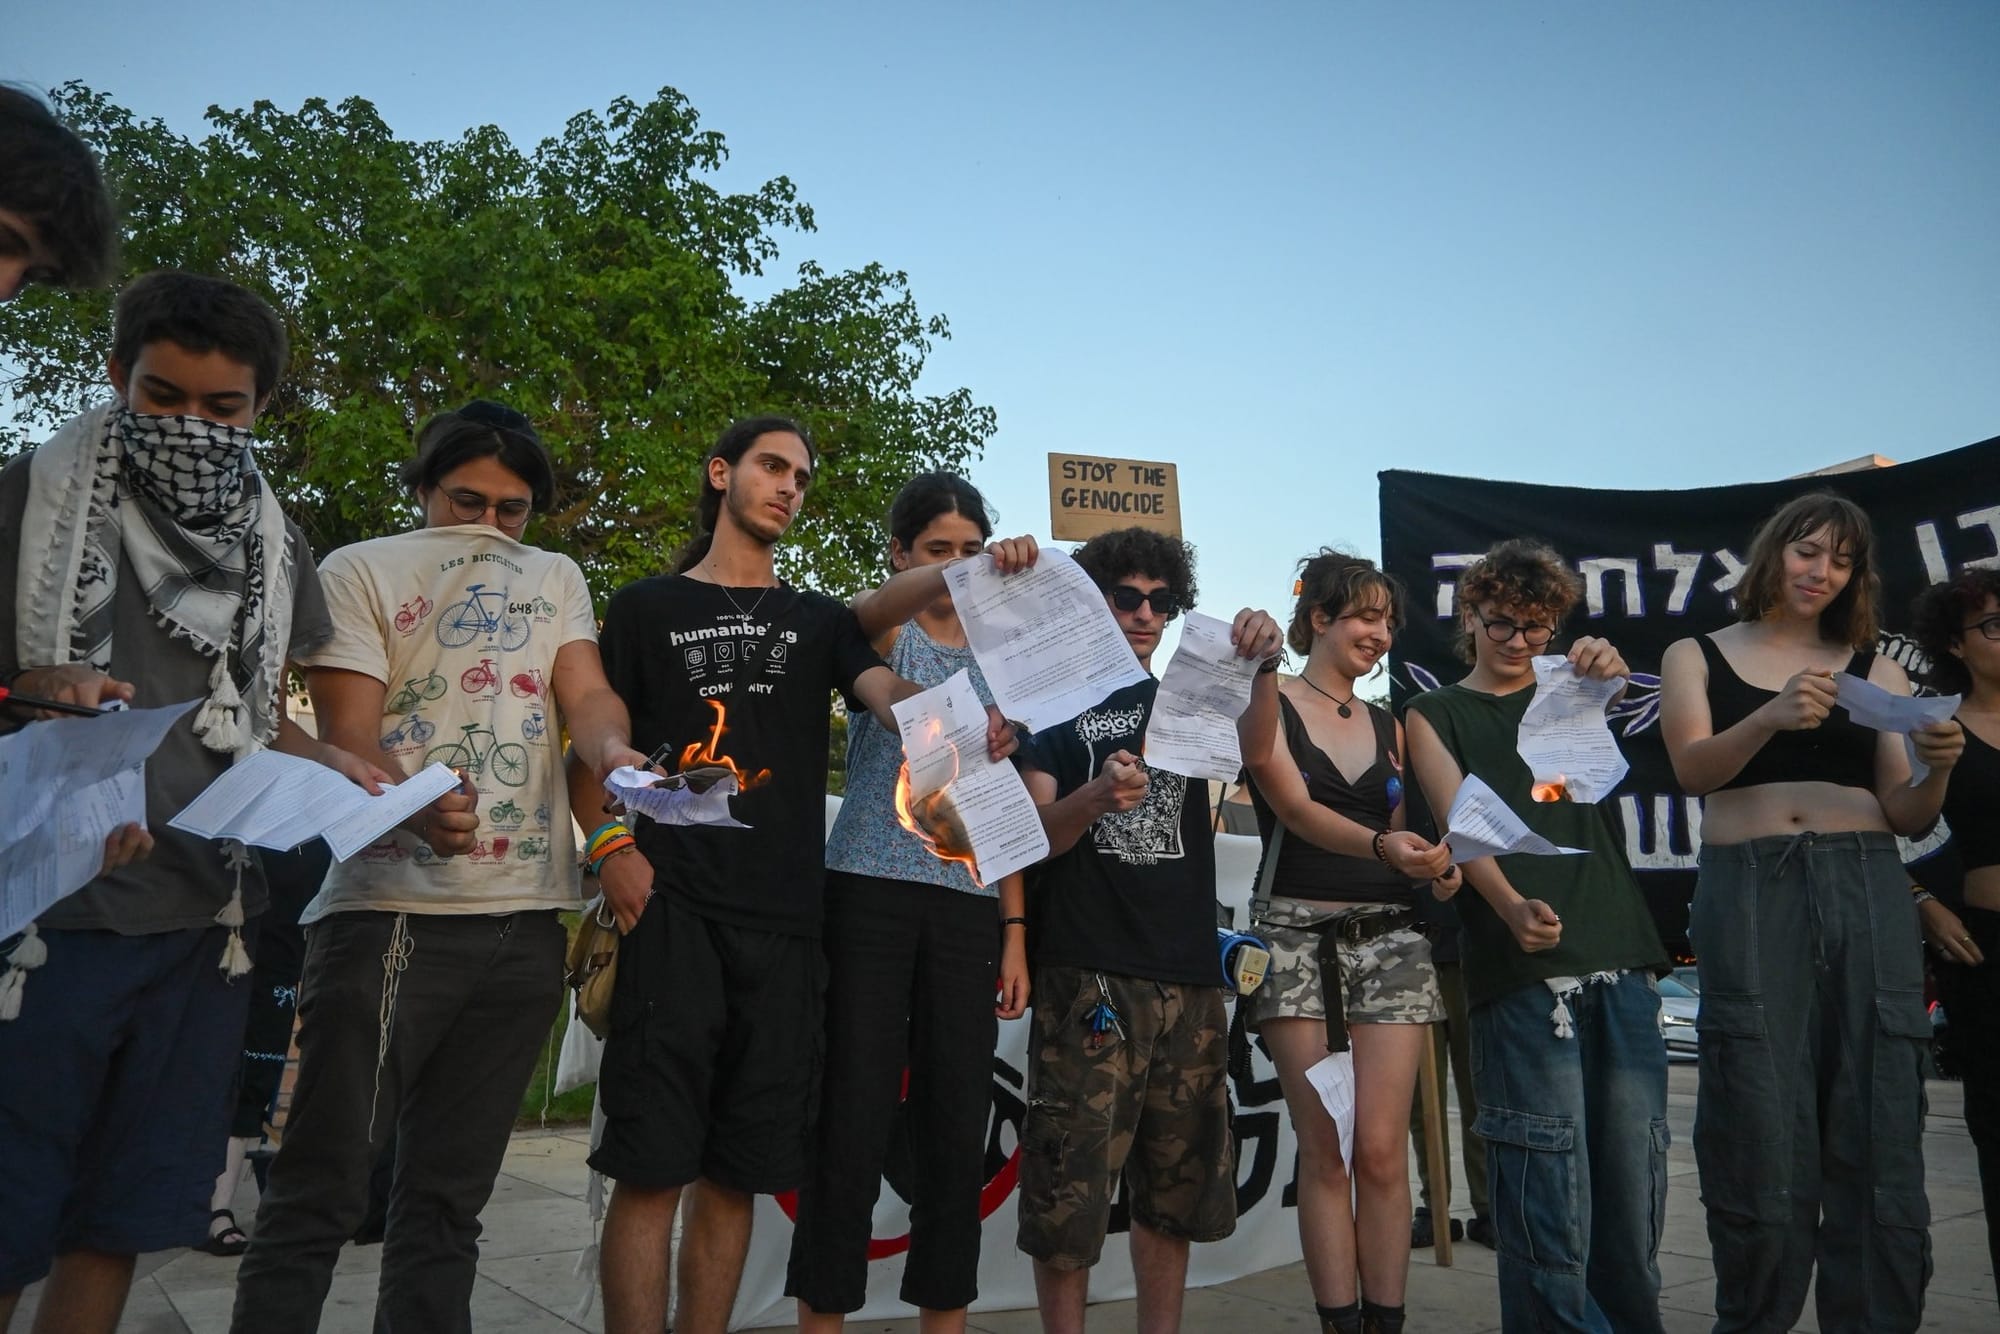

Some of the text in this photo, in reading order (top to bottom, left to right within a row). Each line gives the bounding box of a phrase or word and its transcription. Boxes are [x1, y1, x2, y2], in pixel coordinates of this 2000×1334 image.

[1062, 460, 1167, 487] STOP THE
[1061, 487, 1165, 514] GENOCIDE
[440, 553, 523, 575] LES BICYCLETTES
[508, 602, 532, 615] 648
[669, 621, 798, 647] humanbeg
[699, 682, 774, 697] COMNITY
